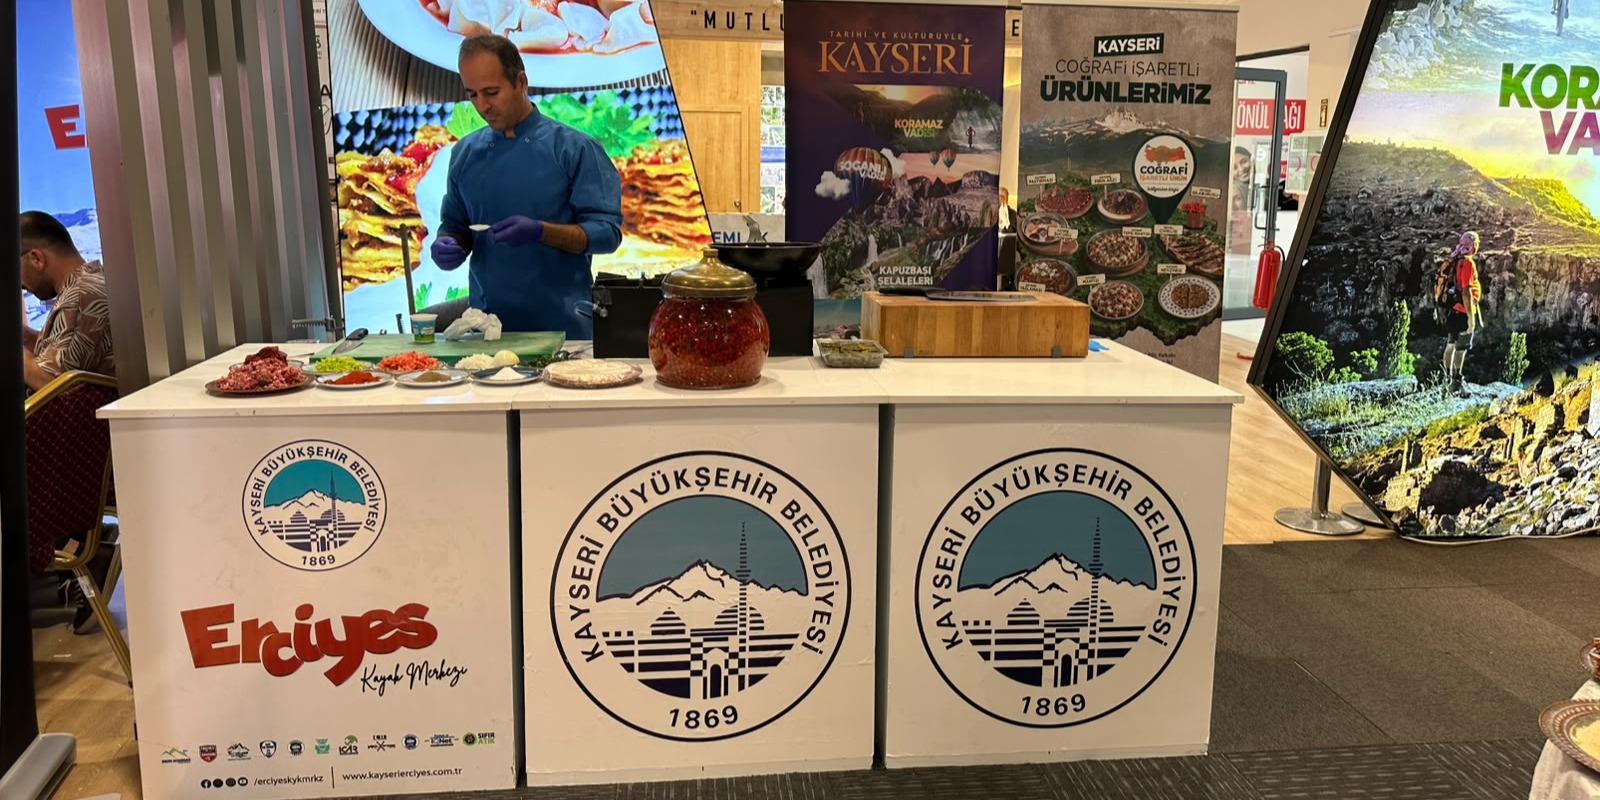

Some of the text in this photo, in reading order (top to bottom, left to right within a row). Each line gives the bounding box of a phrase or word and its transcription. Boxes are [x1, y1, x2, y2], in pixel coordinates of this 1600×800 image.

[874, 31, 886, 39] VE
[817, 37, 973, 75] KAYSERİ
[1499, 63, 1600, 110] KOR
[894, 118, 944, 129] KORAMAZ
[250, 446, 381, 536] KAYSERİ BÜYÜKŞEHİR BELEDİYESİ
[301, 554, 336, 566] 1869
[568, 466, 839, 663] KAYSERİ BÜYÜKŞEHİR BELEDİYESİ
[932, 463, 1186, 650] KAYSERİ BÜYÜKŞEHİR BELEDİYESİ
[180, 602, 438, 686] Erciyes
[360, 663, 403, 697] Kayak
[668, 705, 738, 729] 1869
[1021, 694, 1086, 716] 1869
